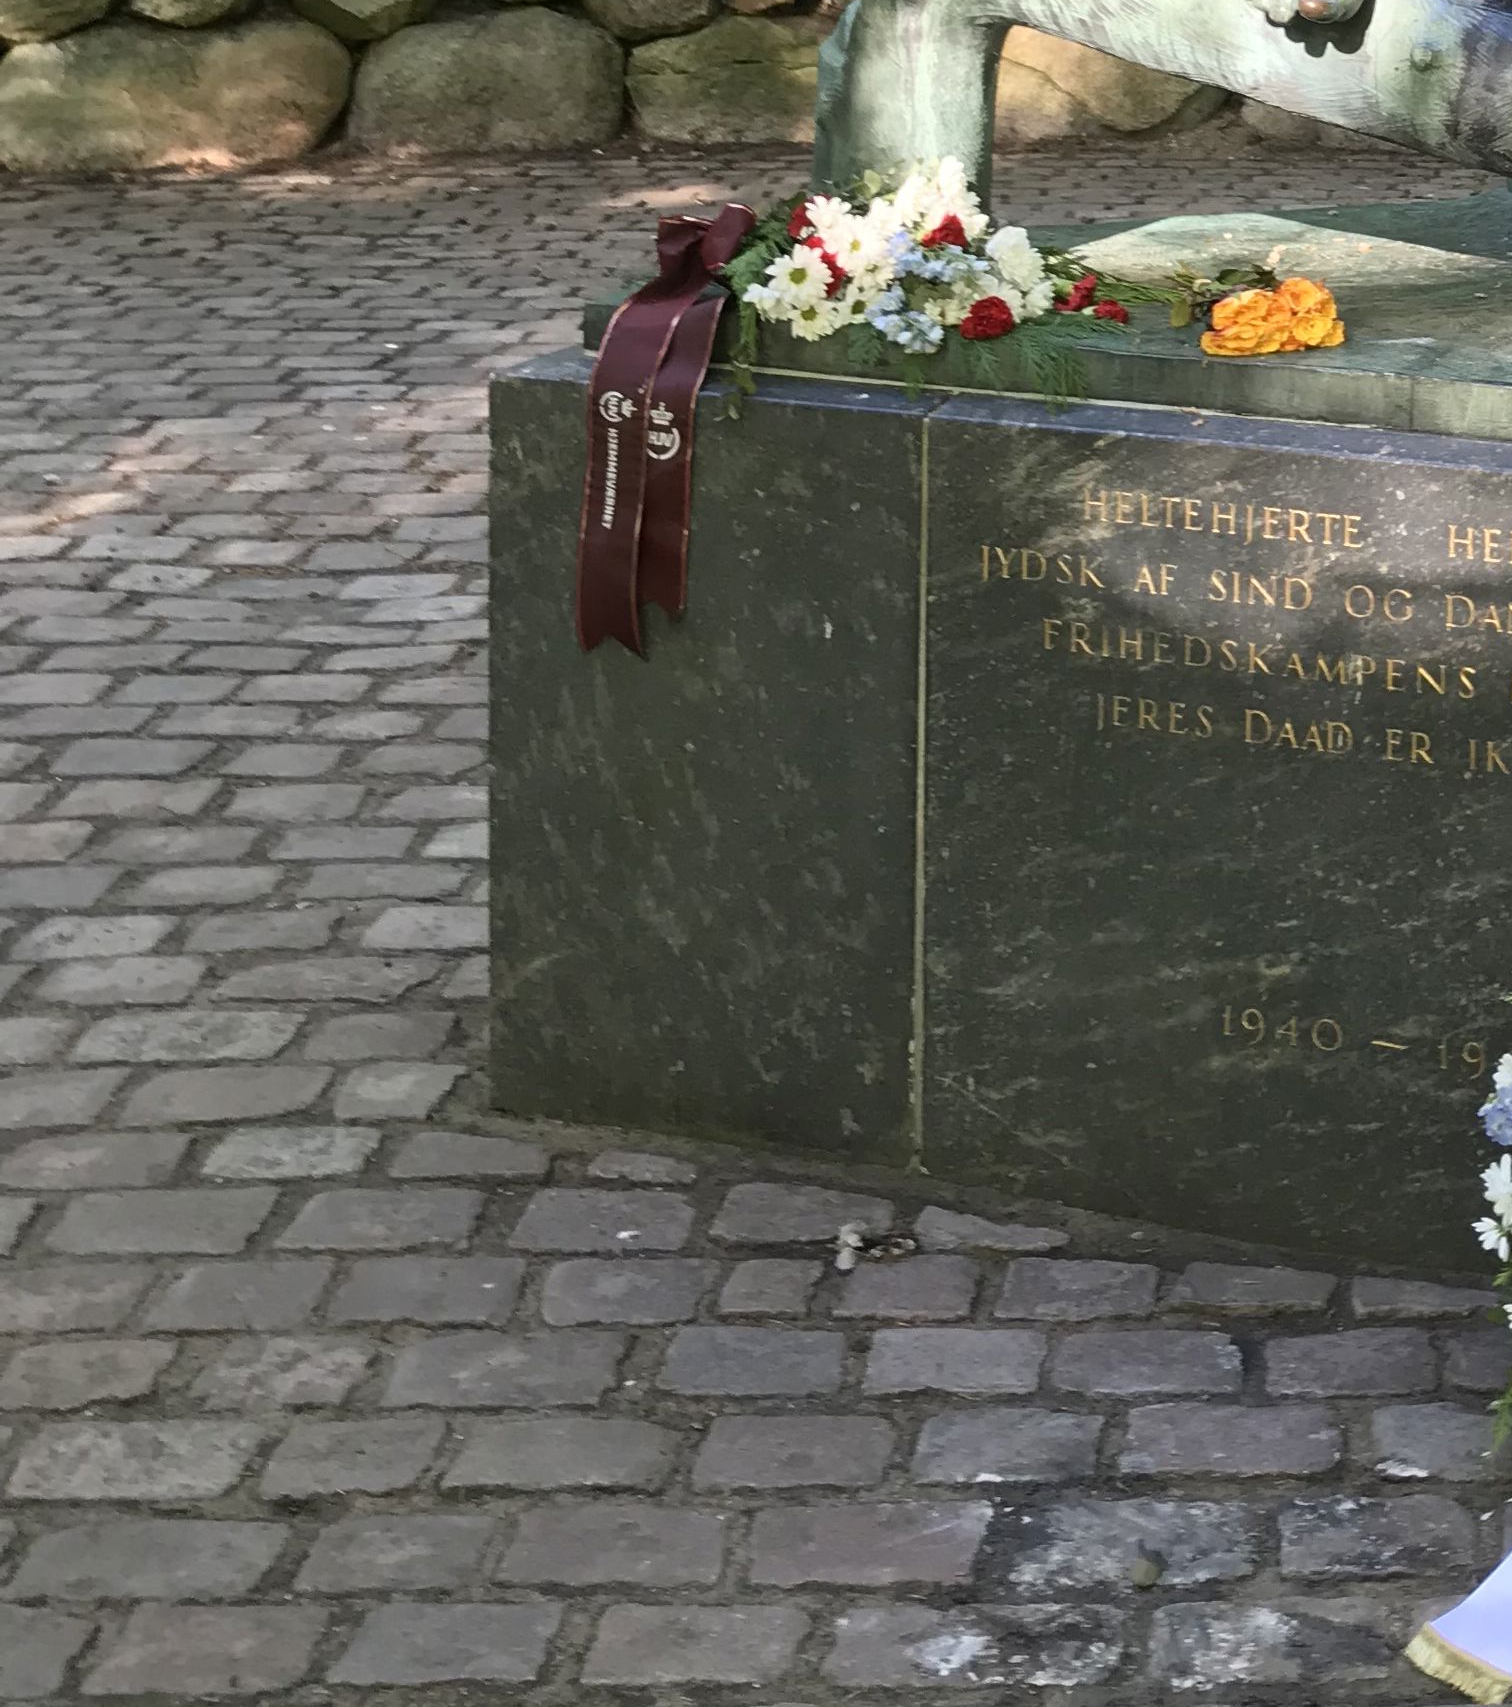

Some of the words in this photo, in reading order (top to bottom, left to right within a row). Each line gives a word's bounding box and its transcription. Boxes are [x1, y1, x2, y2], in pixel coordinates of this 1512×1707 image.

[1084, 488, 1363, 548] HELTEHJERTE
[979, 544, 1105, 588] JYDSK
[1133, 563, 1178, 596] AF
[1208, 568, 1313, 611] SIND
[1344, 584, 1415, 622] OG
[1042, 618, 1477, 699] FRIHEDSKAMPENS
[1097, 693, 1214, 739] JERES
[1244, 709, 1353, 755] DAAD
[1383, 729, 1434, 765] ER
[1221, 1005, 1343, 1051] 1940
[1436, 1035, 1486, 1080] 19
